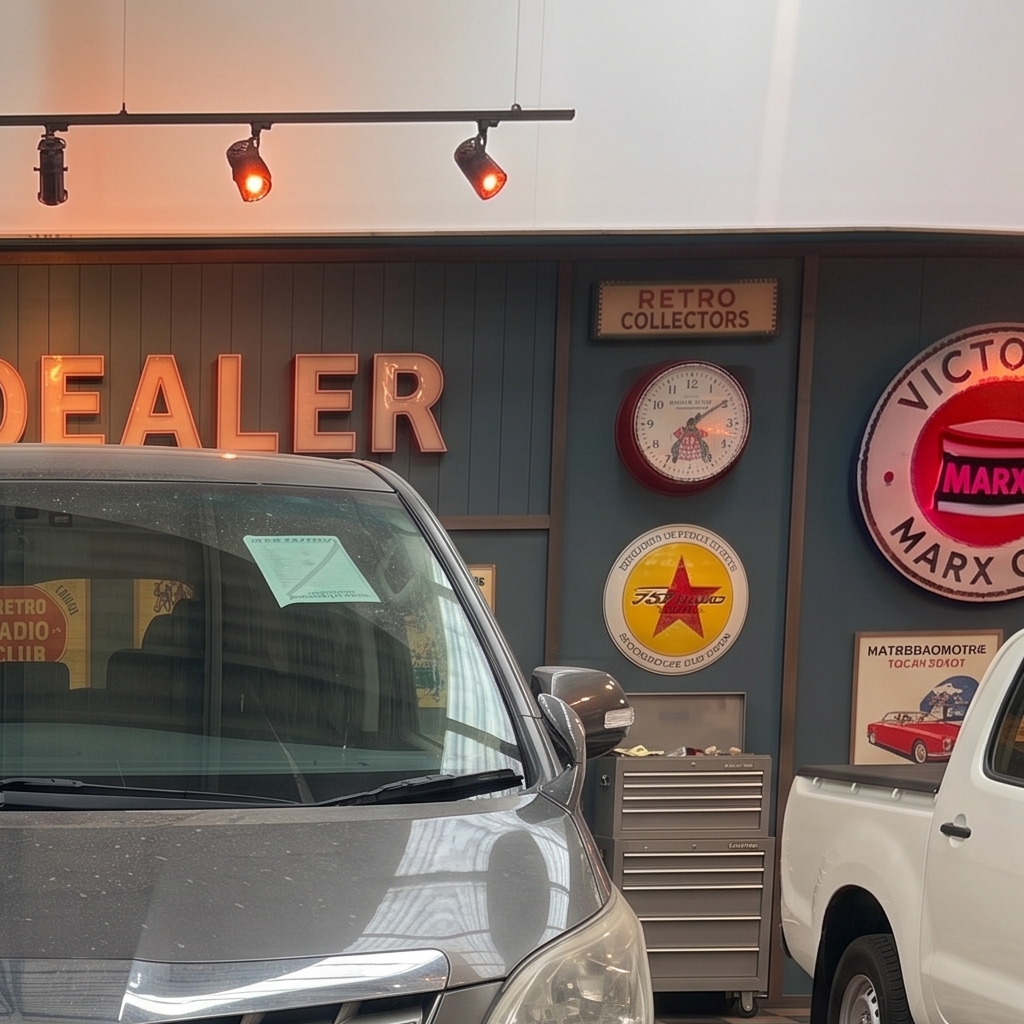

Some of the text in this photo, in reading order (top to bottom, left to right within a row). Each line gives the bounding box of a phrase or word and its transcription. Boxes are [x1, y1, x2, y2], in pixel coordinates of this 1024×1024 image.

[638, 288, 736, 309] RETRO
[621, 310, 749, 330] COLLECTORS
[687, 379, 698, 389] 12
[653, 401, 664, 410] 10
[647, 420, 654, 428] 9
[726, 419, 733, 428] 3
[652, 440, 659, 448] 8
[942, 462, 1024, 495] MARX
[890, 516, 995, 585] MARX
